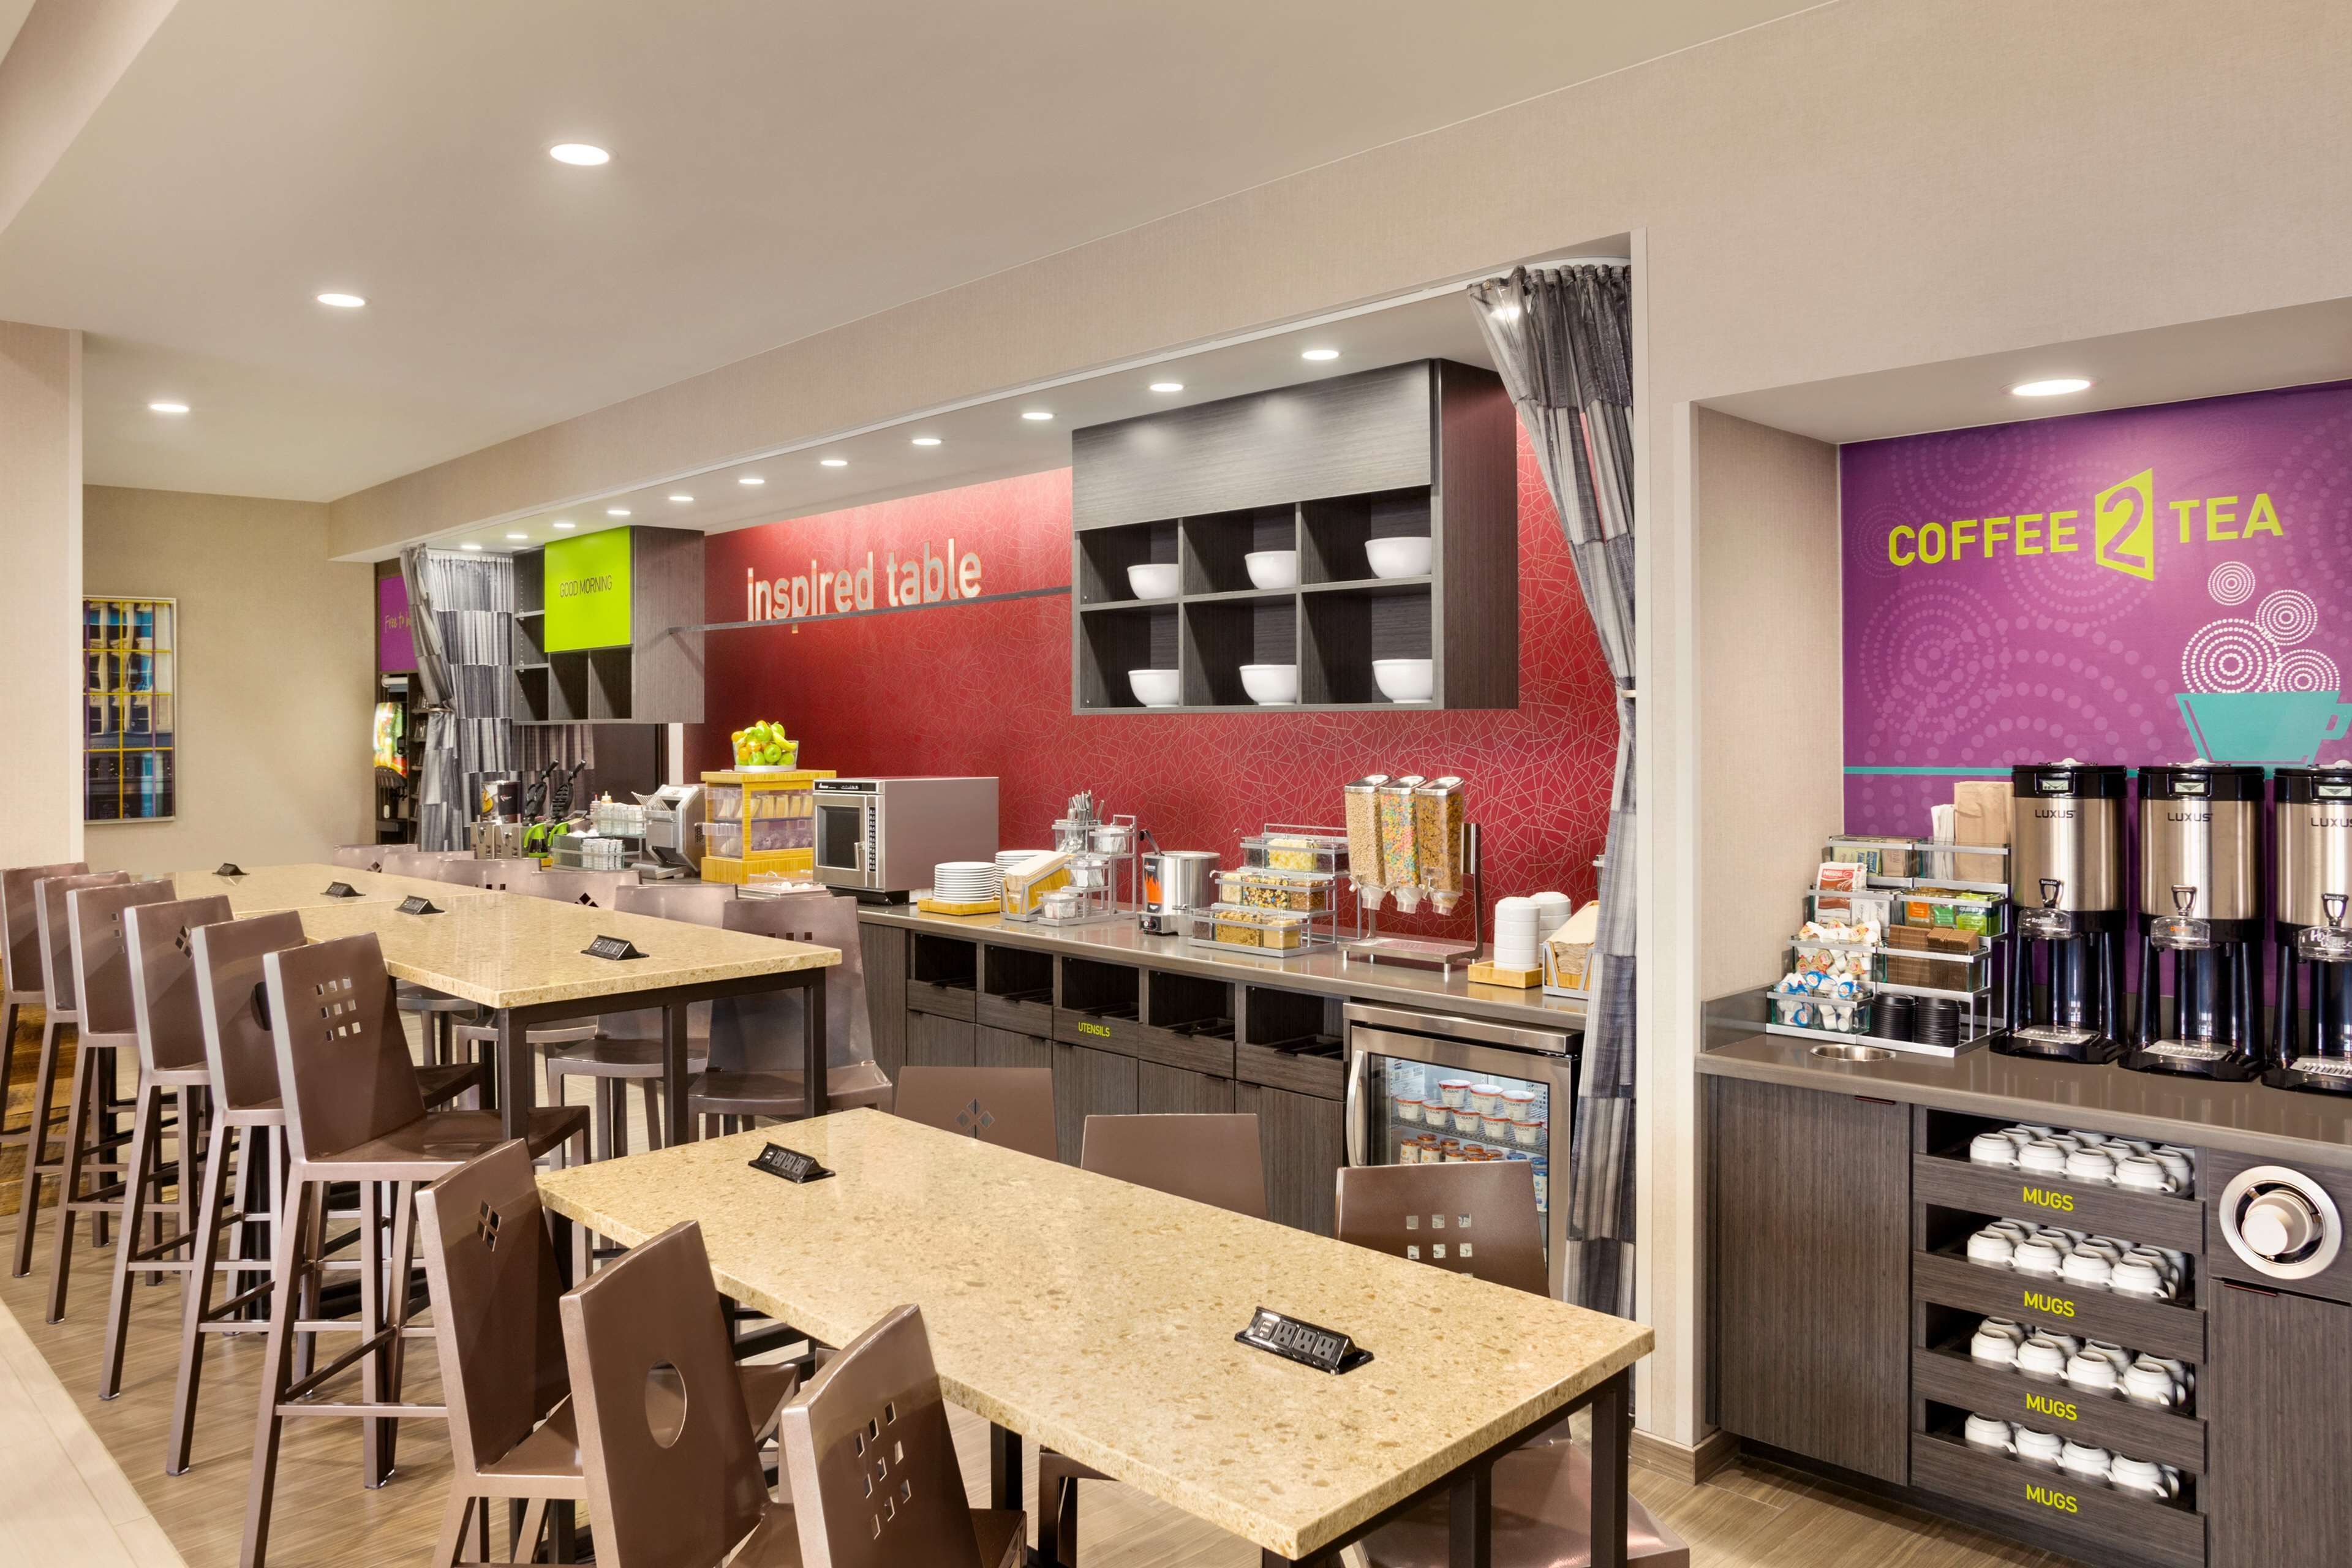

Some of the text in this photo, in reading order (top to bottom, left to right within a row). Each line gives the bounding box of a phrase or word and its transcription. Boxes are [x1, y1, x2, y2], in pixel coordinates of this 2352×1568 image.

[1889, 486, 2283, 569] COFFEE 2 TEA
[560, 575, 612, 598] GOOD MORNING
[747, 537, 982, 633] inspired table
[2035, 809, 2074, 818] LUXUS
[2167, 812, 2211, 822] LUXUS
[1078, 1022, 1111, 1038] UTENSILS
[2023, 1186, 2075, 1212] MUGS
[2024, 1291, 2075, 1318] MUGS
[2026, 1393, 2078, 1422] MUGS
[2026, 1484, 2078, 1514] MUGS
